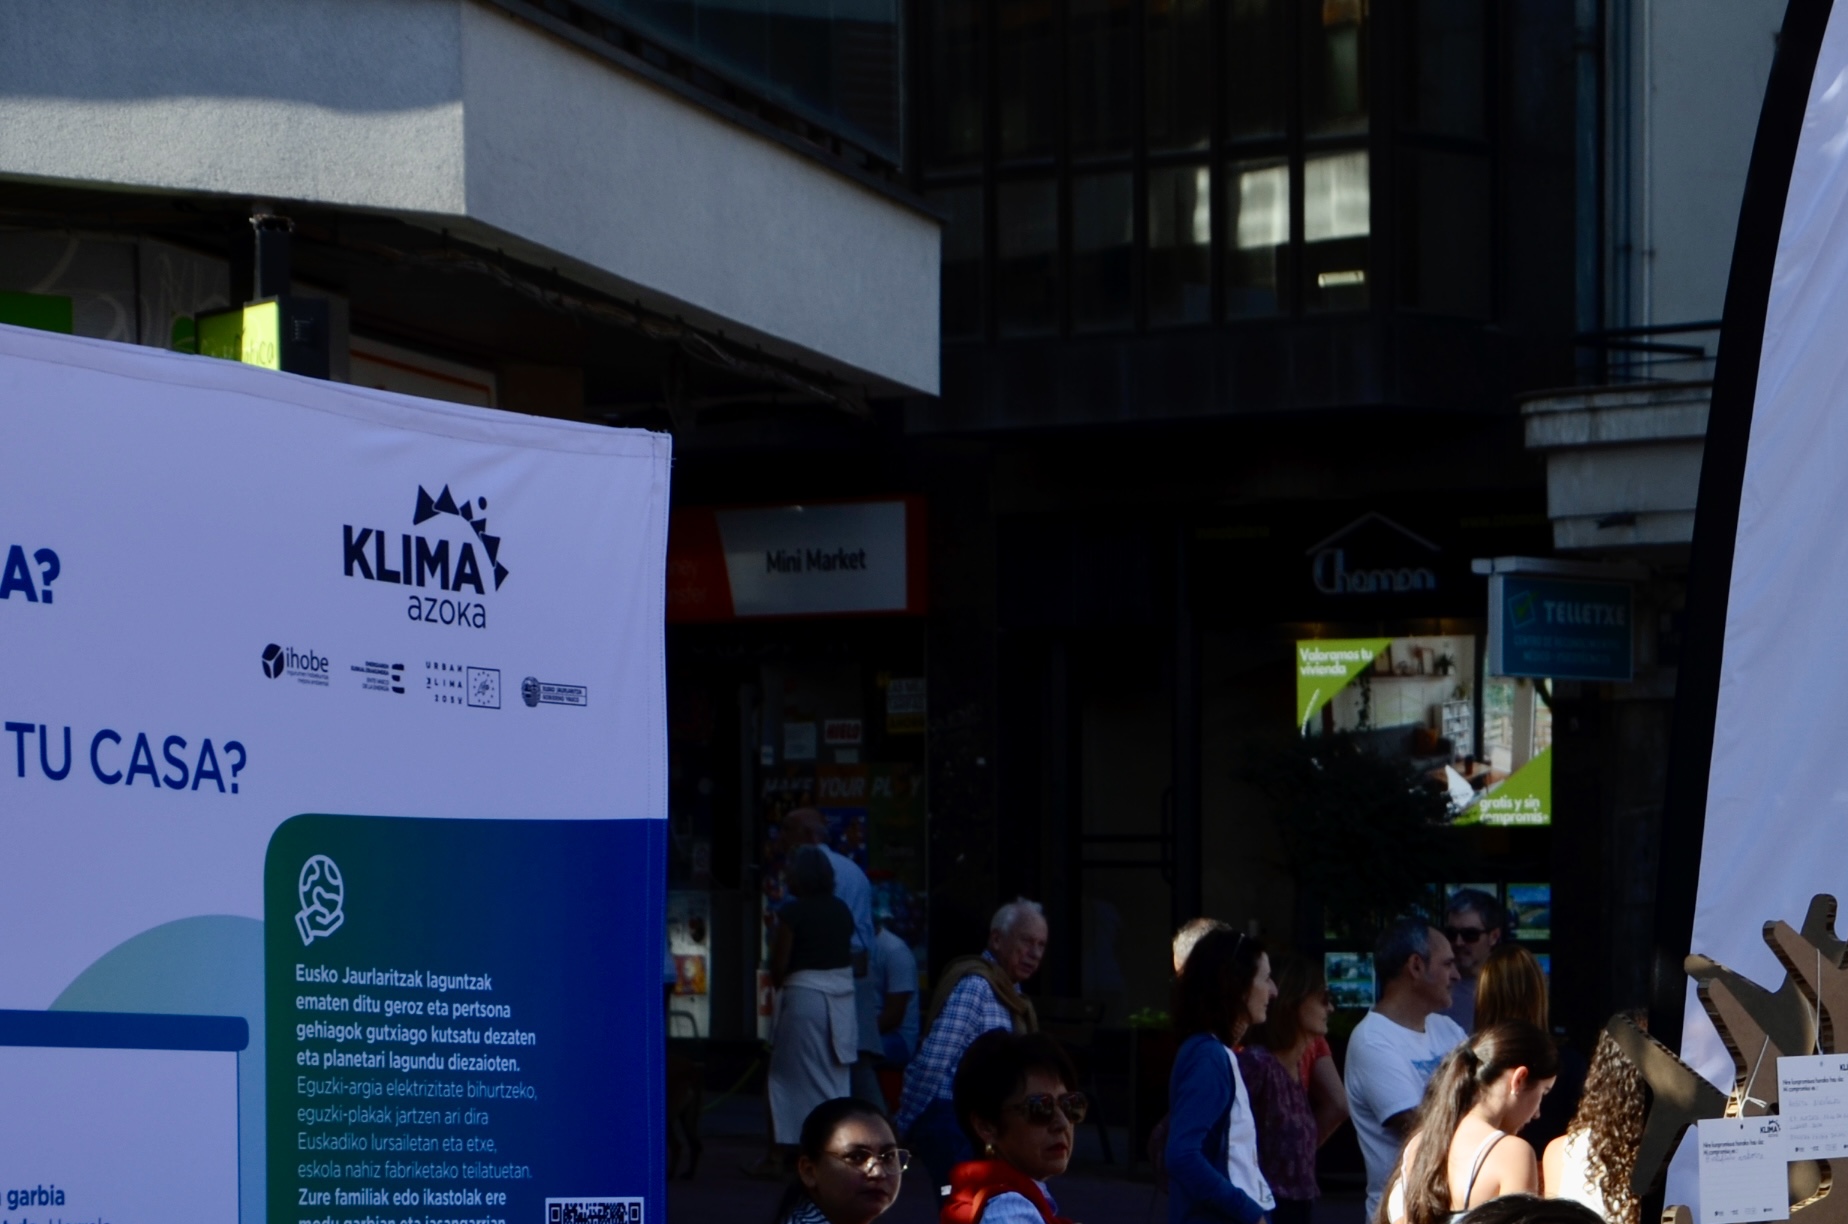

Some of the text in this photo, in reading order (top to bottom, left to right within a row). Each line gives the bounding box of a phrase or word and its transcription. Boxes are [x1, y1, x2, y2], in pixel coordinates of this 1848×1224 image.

[343, 524, 485, 595] KLIMA
[767, 547, 866, 574] Mini Market
[0, 544, 61, 604] A?
[408, 595, 486, 629] azoka
[1544, 600, 1627, 627] TELLETXE
[286, 647, 329, 673] ihobe
[1300, 648, 1373, 662] Valoramos tu
[1301, 664, 1347, 676] vivienda
[5, 721, 247, 794] TU CASA?
[1480, 794, 1540, 811] gratis y sin
[296, 964, 492, 992] Eusko Jaurlaritzak laguntzak
[296, 995, 511, 1019] ematen ditu geroz eta pertsona
[297, 1021, 536, 1045] gehiagok gutxiago kutsatu dezaten
[297, 1050, 520, 1072] eta planetari lagundu diezaioten.
[7, 1184, 65, 1211] garbia
[299, 1188, 506, 1205] Zure familiak edo ikastolak ere
